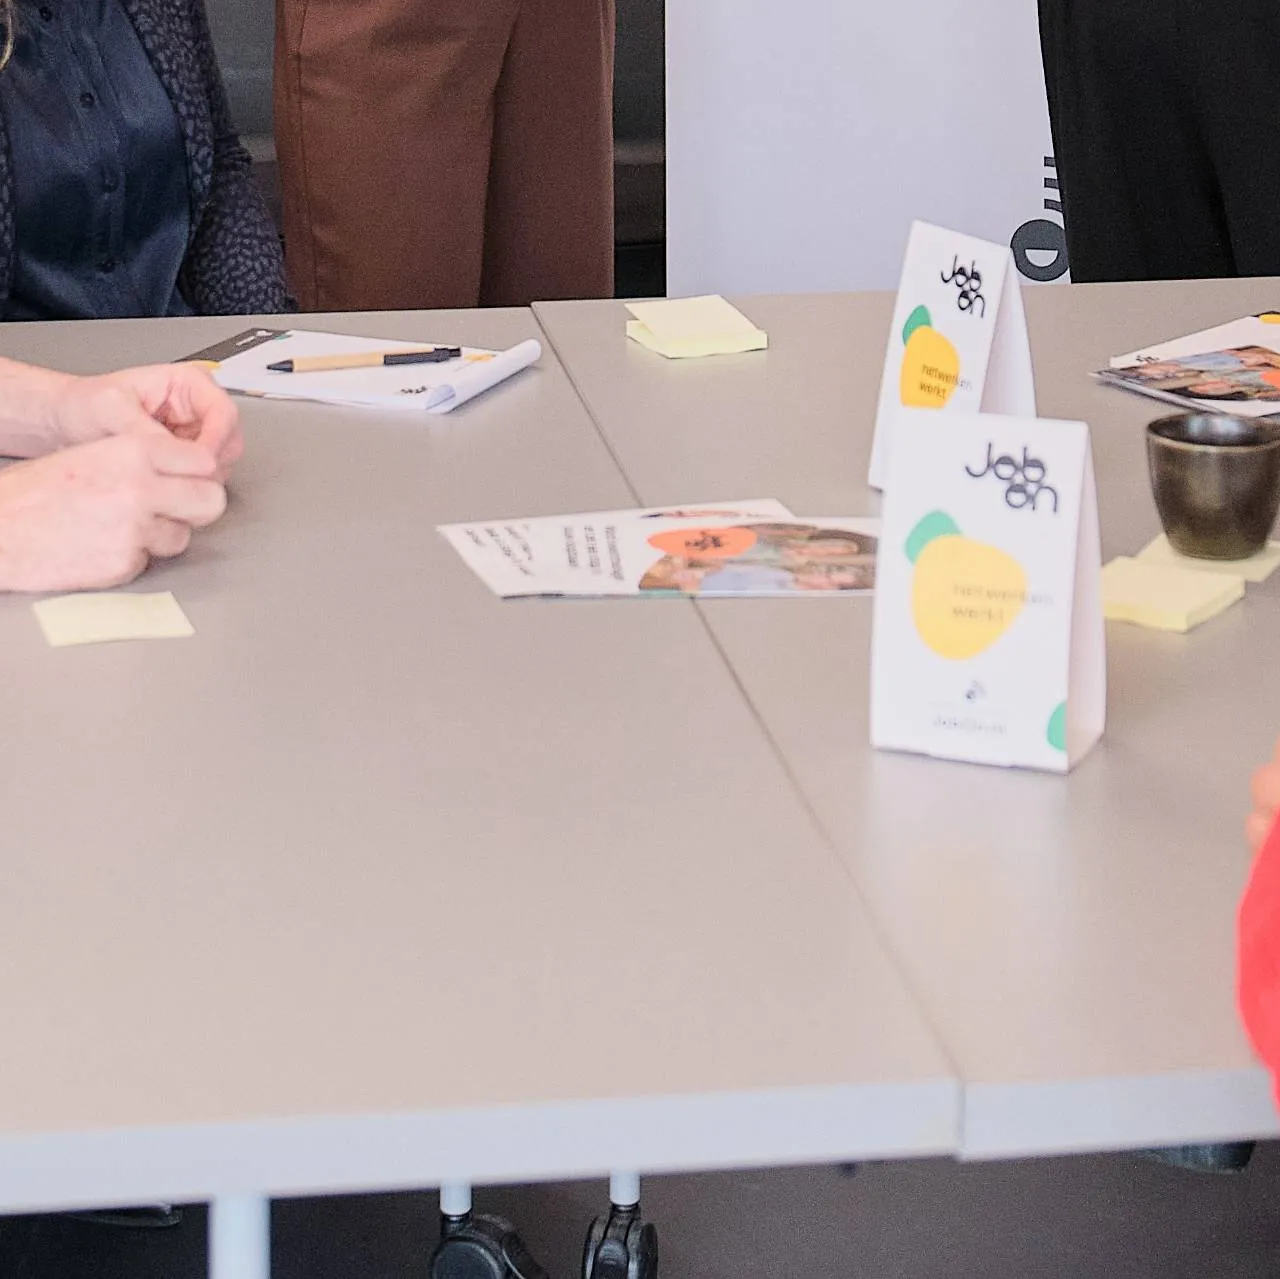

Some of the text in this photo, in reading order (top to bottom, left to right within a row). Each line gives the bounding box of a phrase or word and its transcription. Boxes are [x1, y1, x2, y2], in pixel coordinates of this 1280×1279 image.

[940, 253, 982, 292] Job
[965, 441, 1047, 483] Job
[1005, 483, 1059, 514] on
